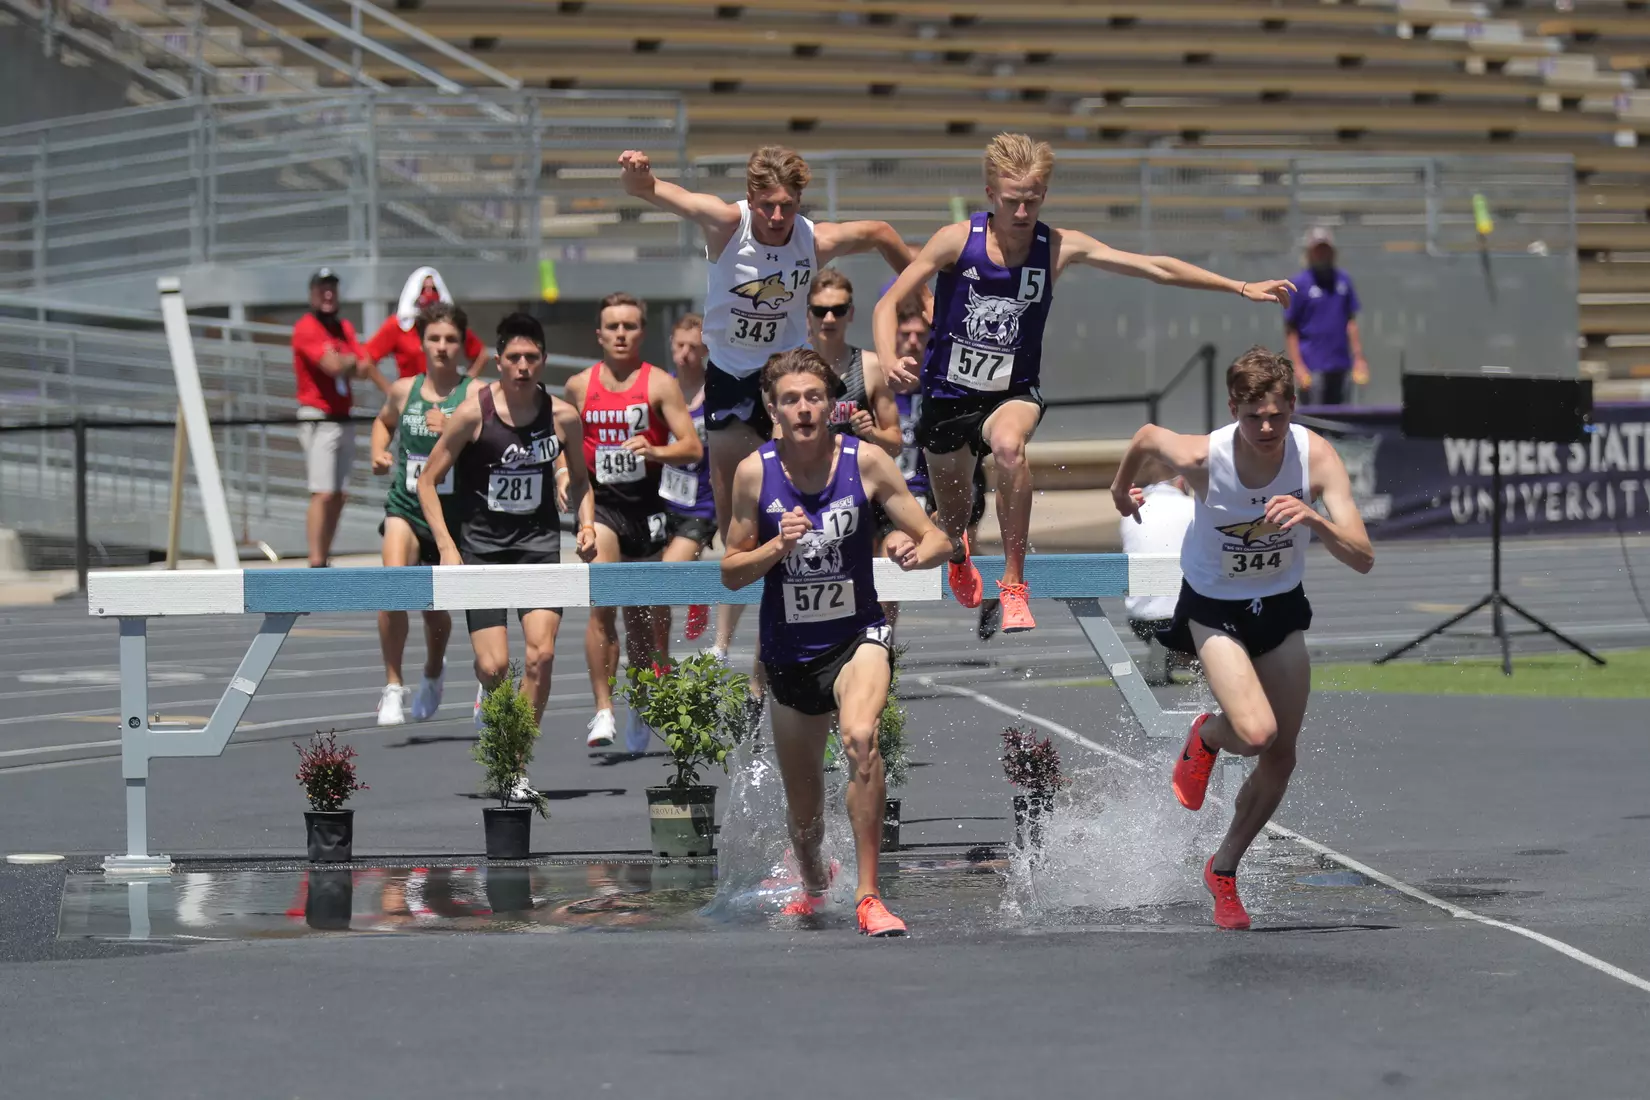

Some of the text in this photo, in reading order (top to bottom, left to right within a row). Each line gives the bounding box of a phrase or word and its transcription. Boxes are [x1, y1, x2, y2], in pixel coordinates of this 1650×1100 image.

[791, 269, 811, 290] 14
[1023, 269, 1042, 300] 5
[734, 318, 778, 343] 343
[958, 347, 1005, 381] 577
[632, 407, 645, 431] 2
[538, 438, 556, 460] 10
[1443, 438, 1560, 476] WEBER
[603, 453, 637, 474] 499
[496, 477, 533, 501] 281
[829, 510, 854, 538] 12
[1232, 552, 1282, 573] 344
[794, 583, 845, 612] 572
